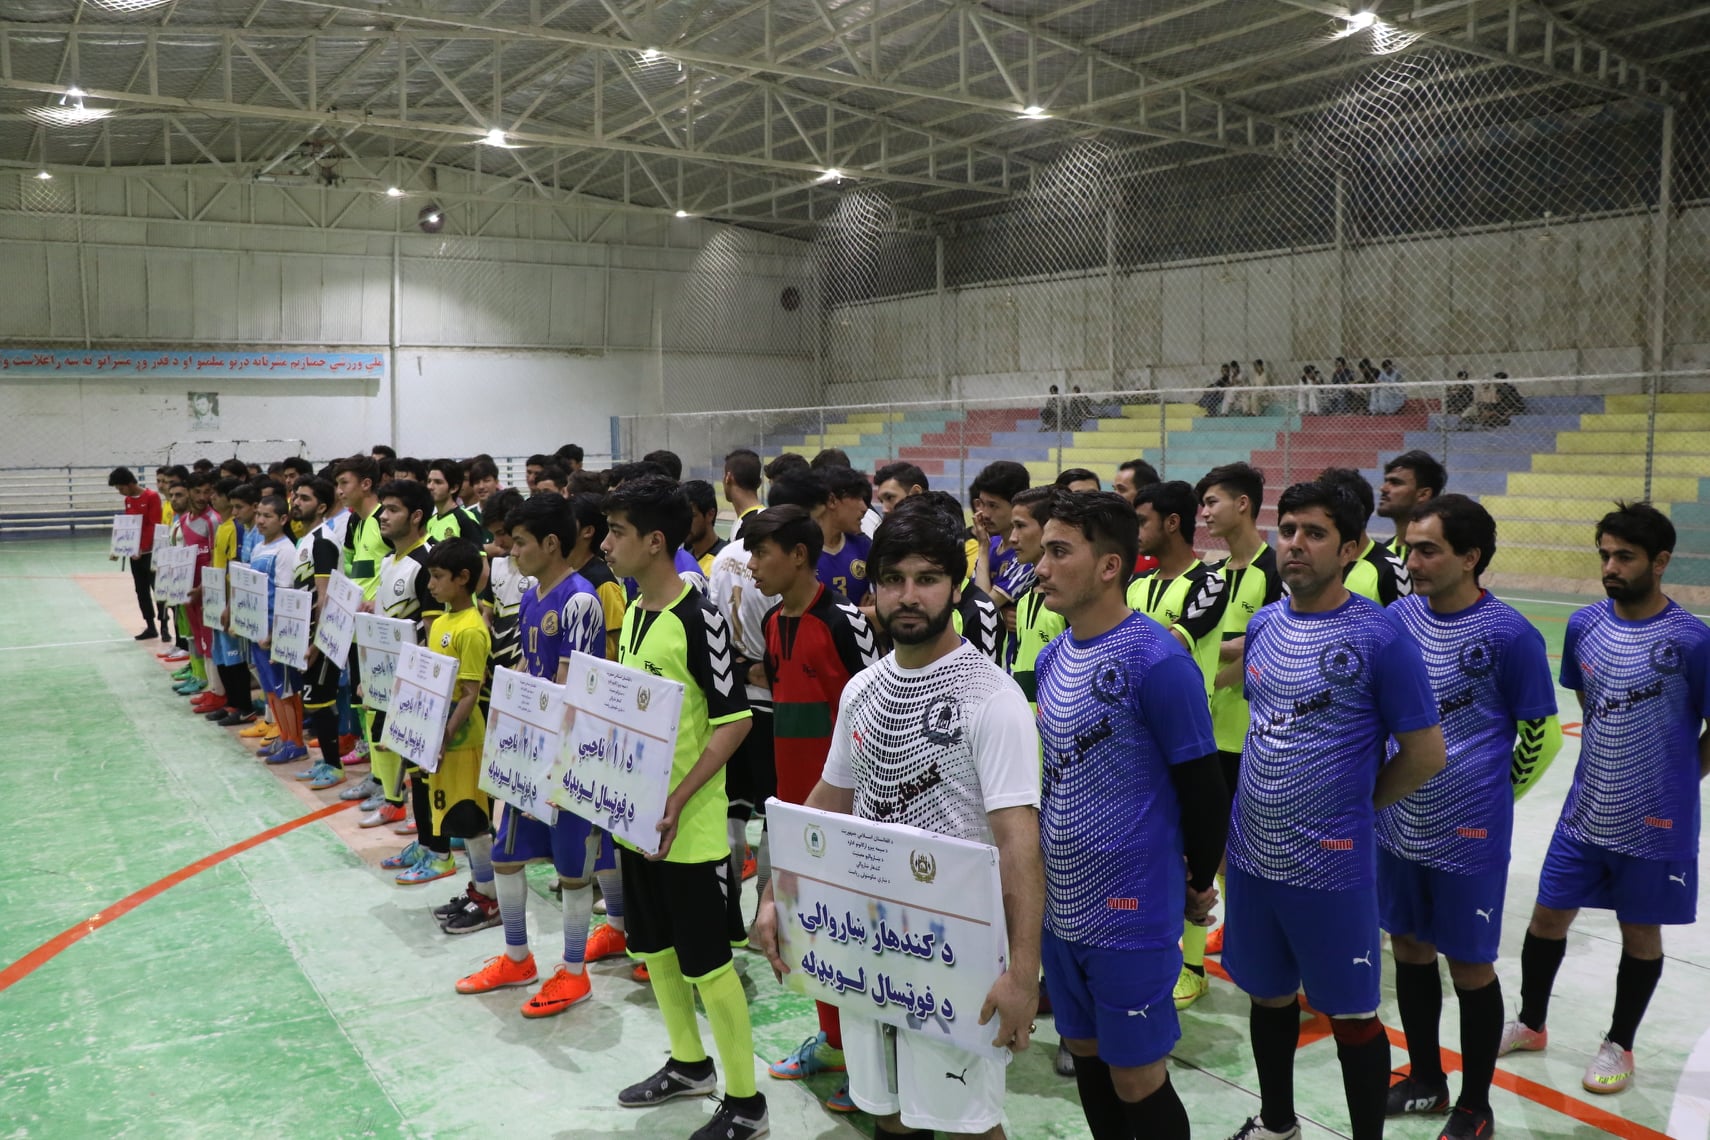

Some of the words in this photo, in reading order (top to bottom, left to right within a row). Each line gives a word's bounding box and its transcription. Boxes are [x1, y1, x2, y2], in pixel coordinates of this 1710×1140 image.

[303, 684, 312, 700] 2
[626, 753, 633, 770] د
[434, 789, 446, 811] 8
[627, 802, 634, 819] د
[872, 920, 935, 958] کندهار
[941, 942, 954, 965] د
[871, 974, 936, 1020] فوټسال
[941, 997, 954, 1018] د
